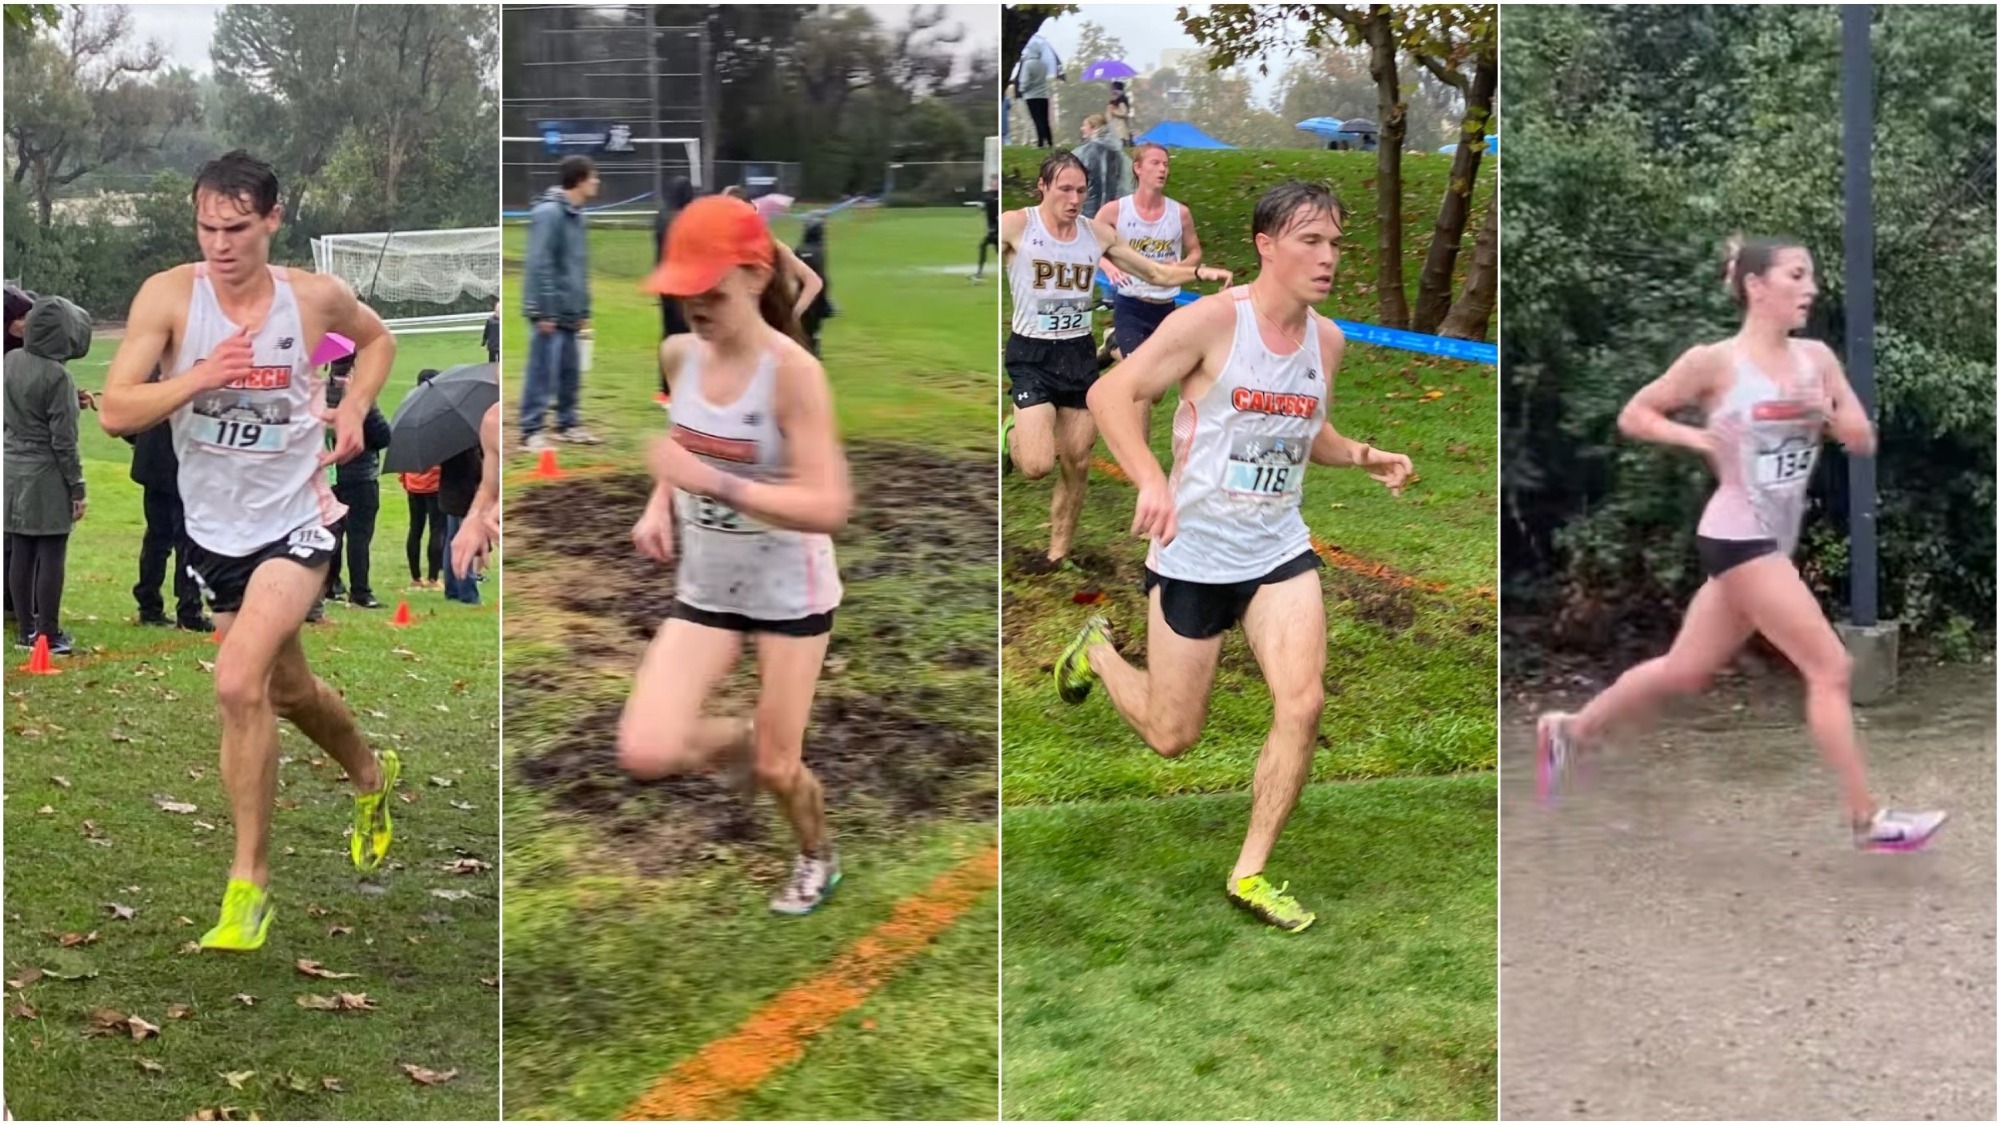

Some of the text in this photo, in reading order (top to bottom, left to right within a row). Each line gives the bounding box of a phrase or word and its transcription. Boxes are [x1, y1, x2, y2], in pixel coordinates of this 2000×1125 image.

[1032, 259, 1094, 292] PLU
[1048, 314, 1083, 330] 332
[1232, 386, 1319, 419] CALTECH
[216, 420, 262, 447] 119
[1252, 466, 1289, 492] 118
